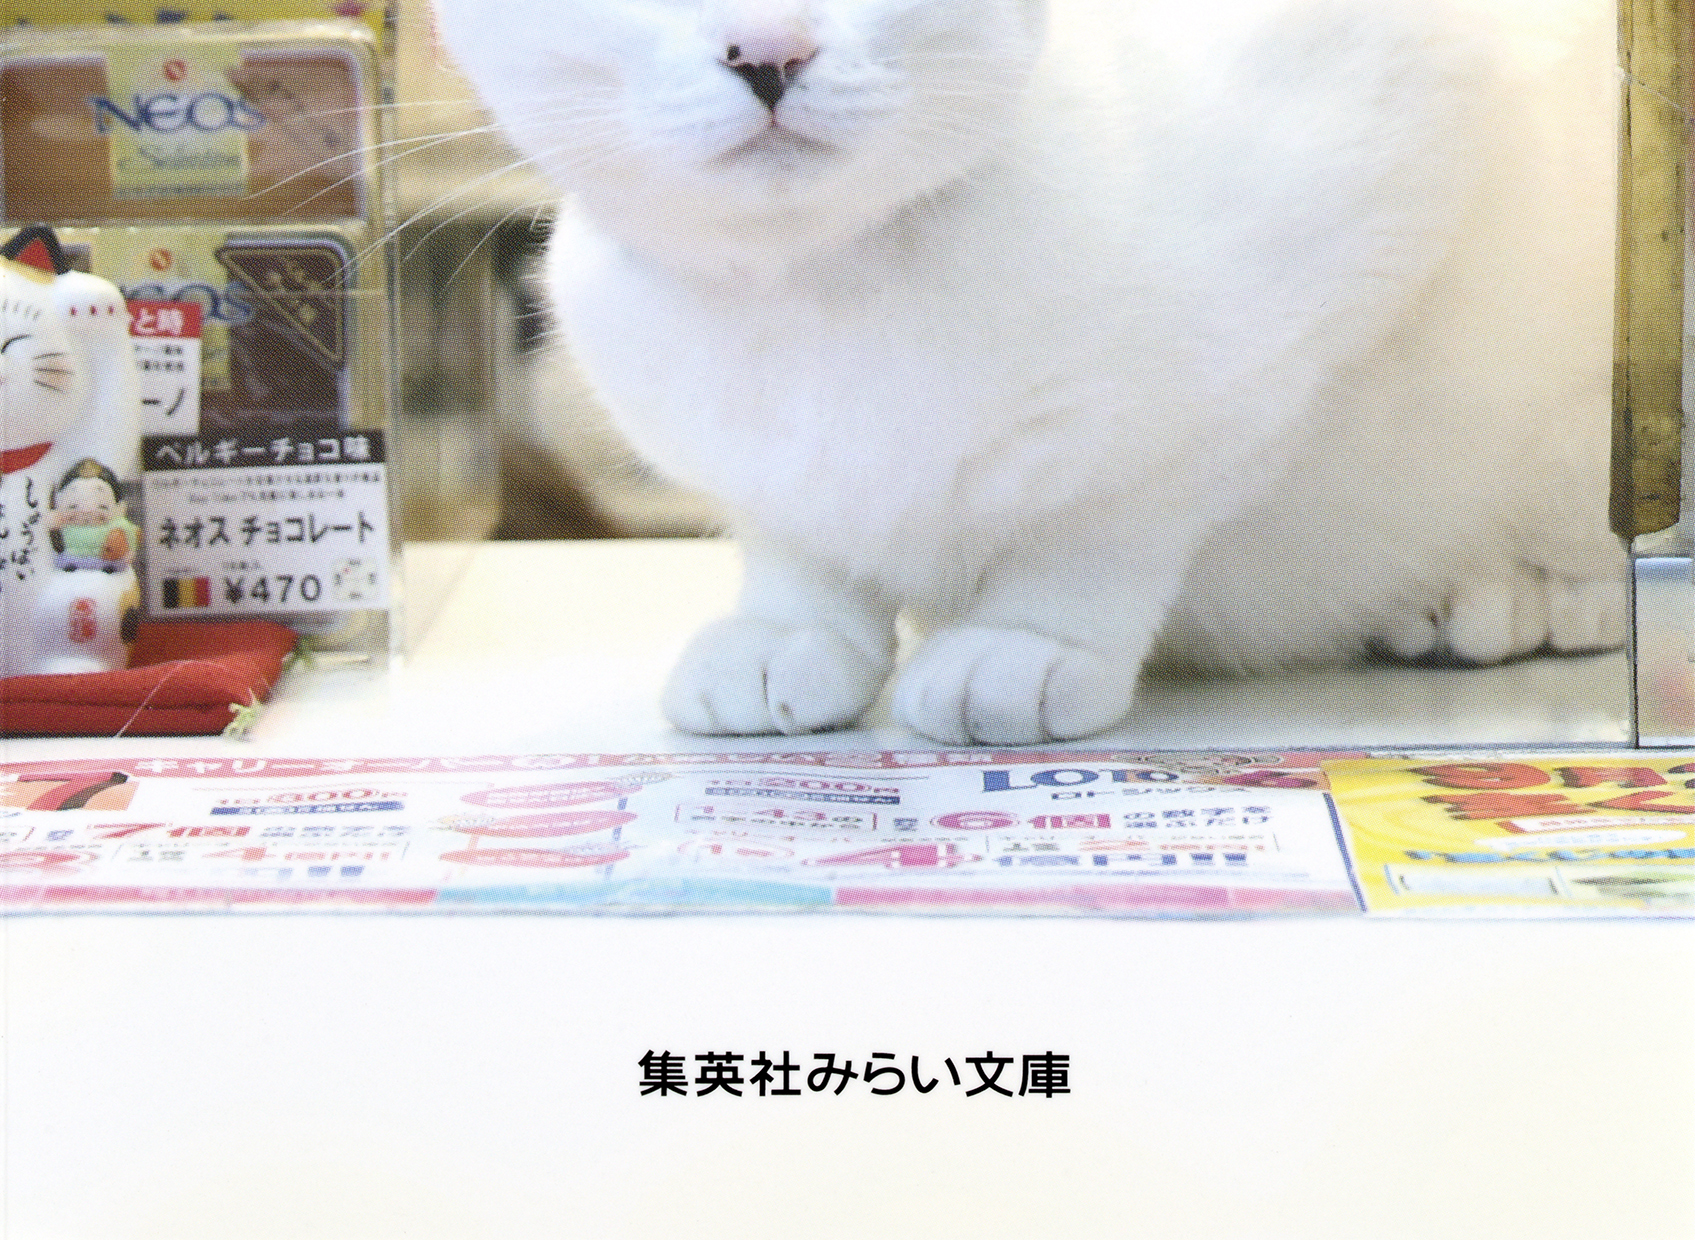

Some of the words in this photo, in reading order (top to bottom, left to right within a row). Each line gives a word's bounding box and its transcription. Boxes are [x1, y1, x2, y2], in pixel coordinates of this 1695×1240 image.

[155, 434, 372, 467] ベルギーチョコ味
[158, 515, 231, 550] ネオス
[240, 510, 376, 547] チョコレート
[224, 573, 323, 604] ¥470
